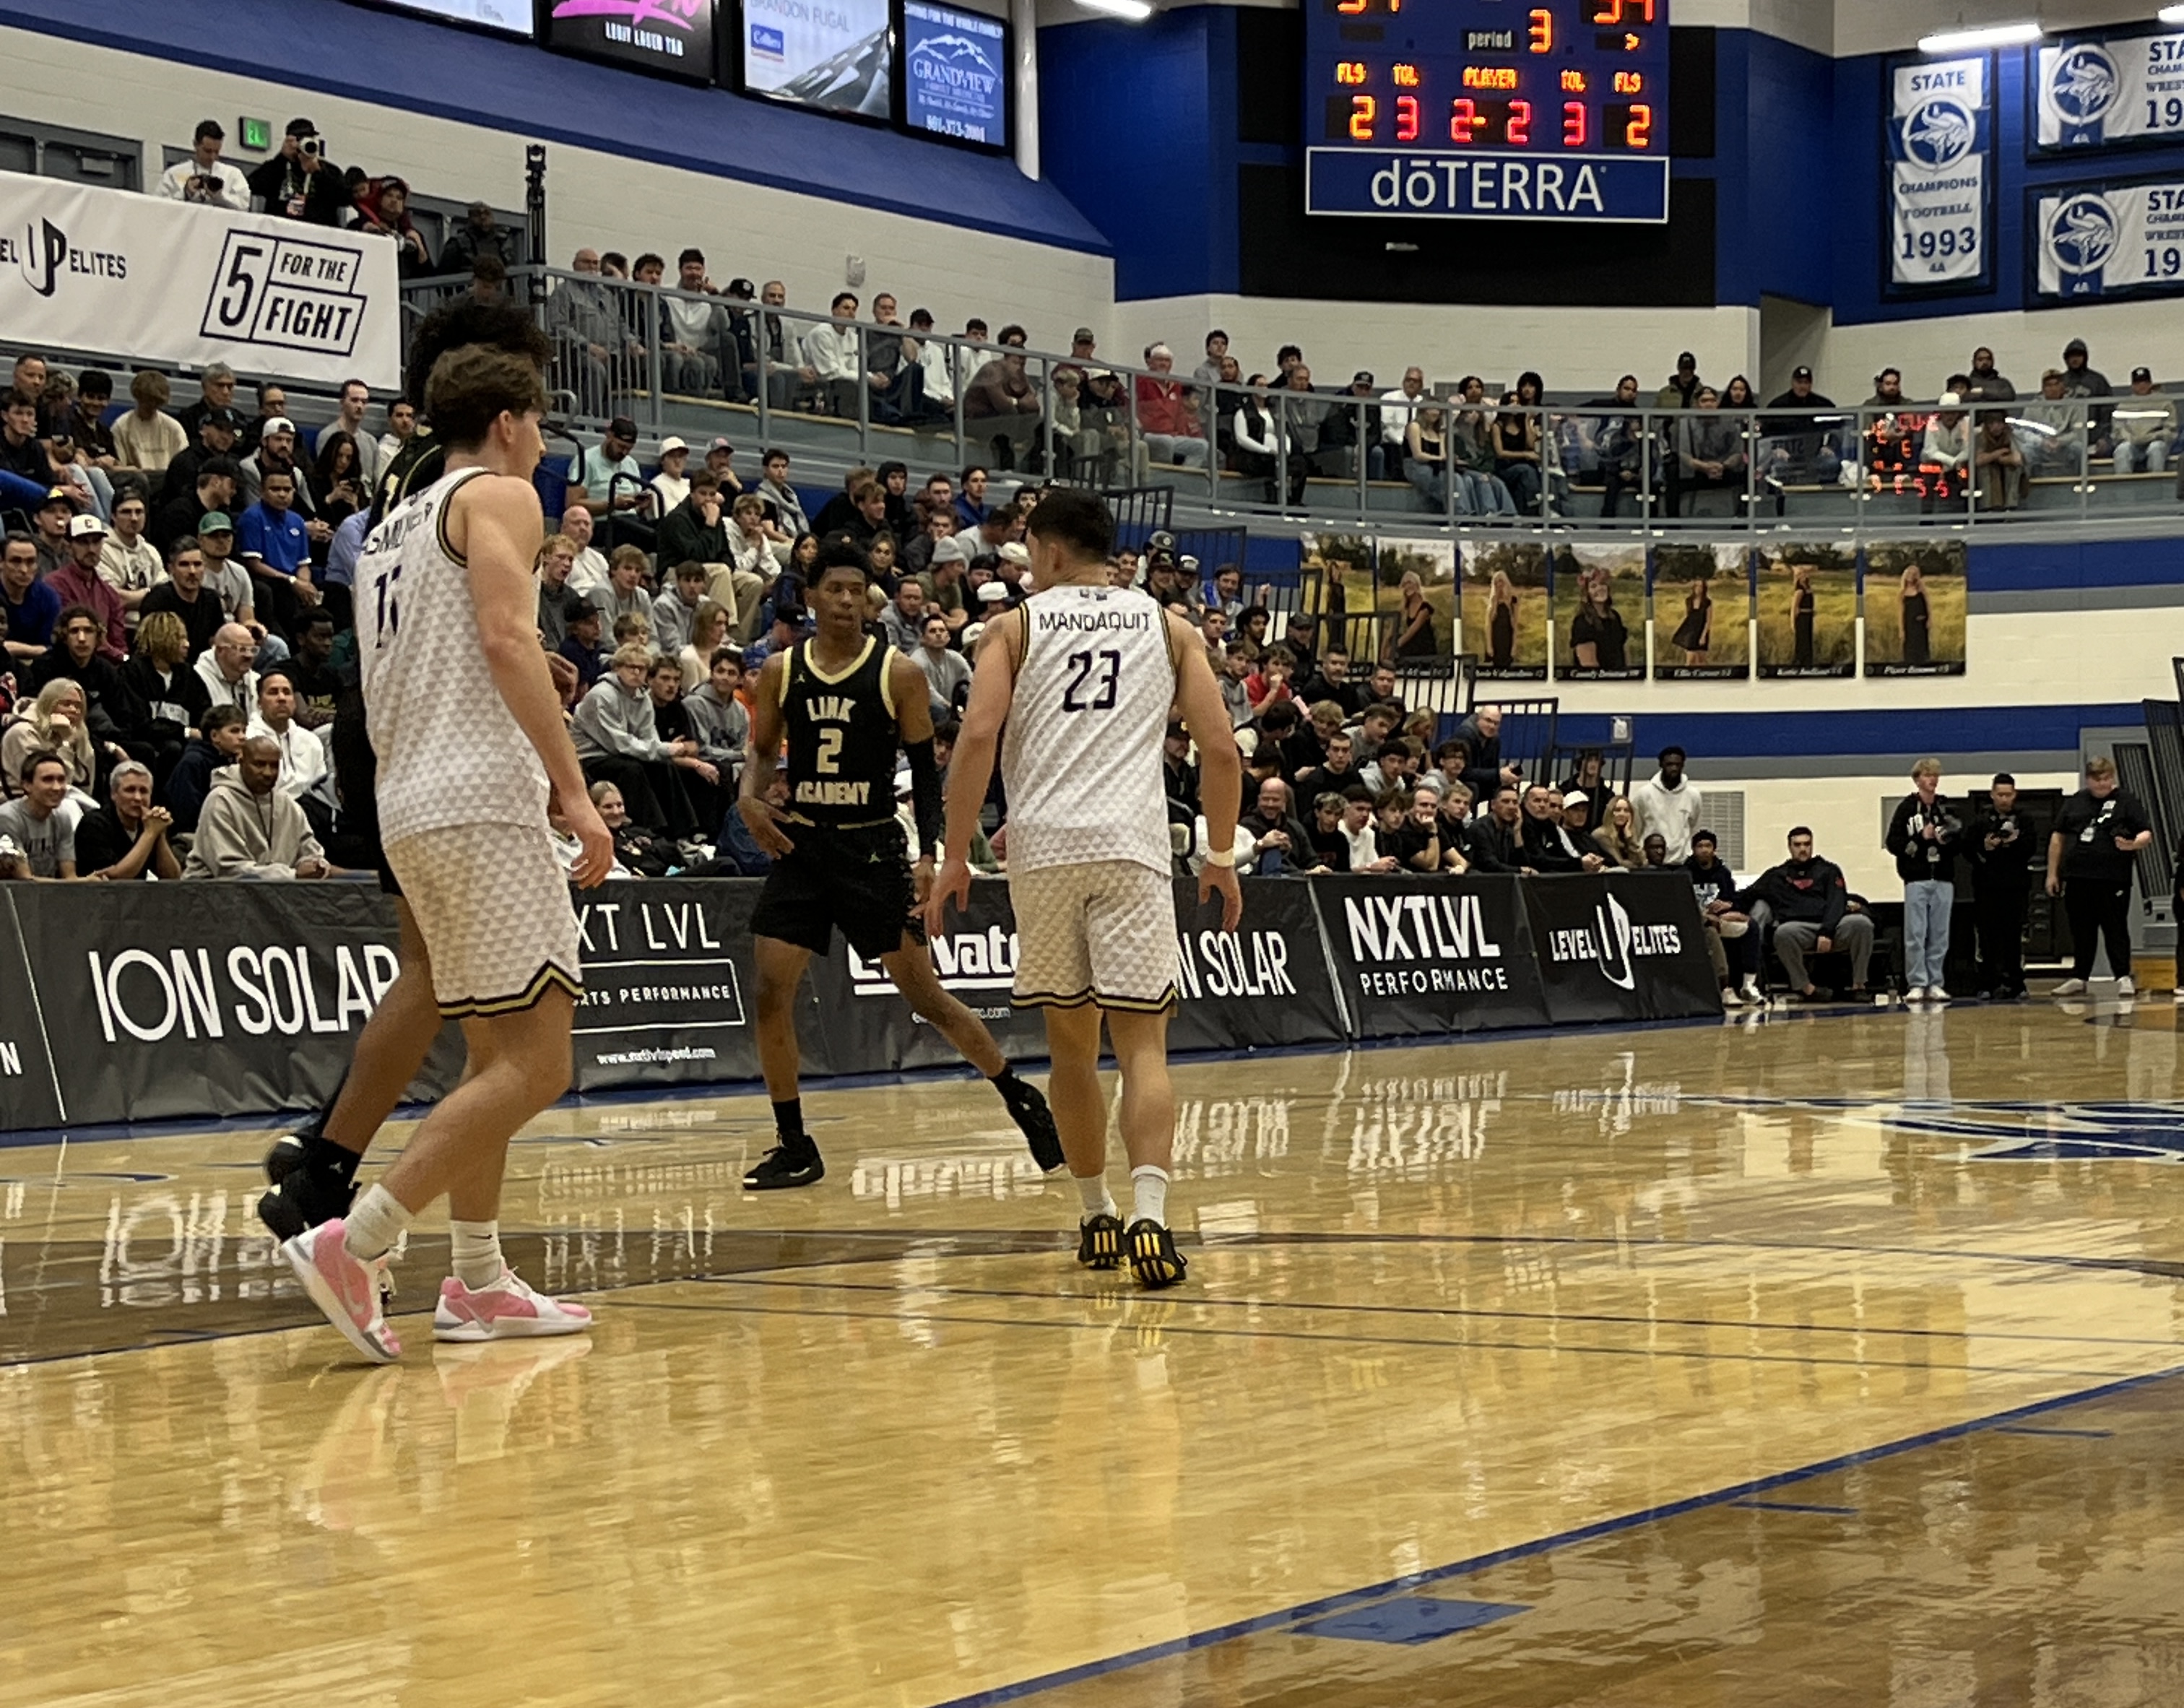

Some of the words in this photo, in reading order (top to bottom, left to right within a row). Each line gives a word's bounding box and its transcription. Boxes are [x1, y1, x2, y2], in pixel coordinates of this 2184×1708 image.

[1468, 30, 1512, 50] period
[1528, 9, 1552, 53] 3
[1462, 66, 1517, 90] PLAYER
[1911, 69, 1966, 91] STATE
[1349, 95, 1376, 141] 2
[1397, 95, 1419, 141] 3
[1507, 99, 1531, 144] 2
[1563, 101, 1587, 146] 3
[1626, 104, 1651, 148] 2
[1899, 176, 1977, 195] CHAMPIONS
[1902, 226, 1976, 259] 1993
[69, 248, 127, 279] ELITES
[280, 252, 313, 277] FOR
[317, 257, 347, 282] THE
[219, 245, 263, 326] 5
[265, 296, 353, 342] FIGHT
[1039, 610, 1151, 632] MANDAQUIT
[1062, 649, 1121, 712] 23
[805, 695, 857, 723] LINK
[817, 727, 844, 773] 2
[641, 903, 720, 949] LVL
[1344, 895, 1502, 962] NXTLVL
[1549, 928, 1598, 961] LEVEL
[1631, 924, 1681, 955] ELITES
[1199, 929, 1297, 997] SOLAR
[1359, 968, 1509, 995] PERFORMANCE
[89, 948, 224, 1041] ION
[619, 985, 731, 1003] PERFORMANCE
